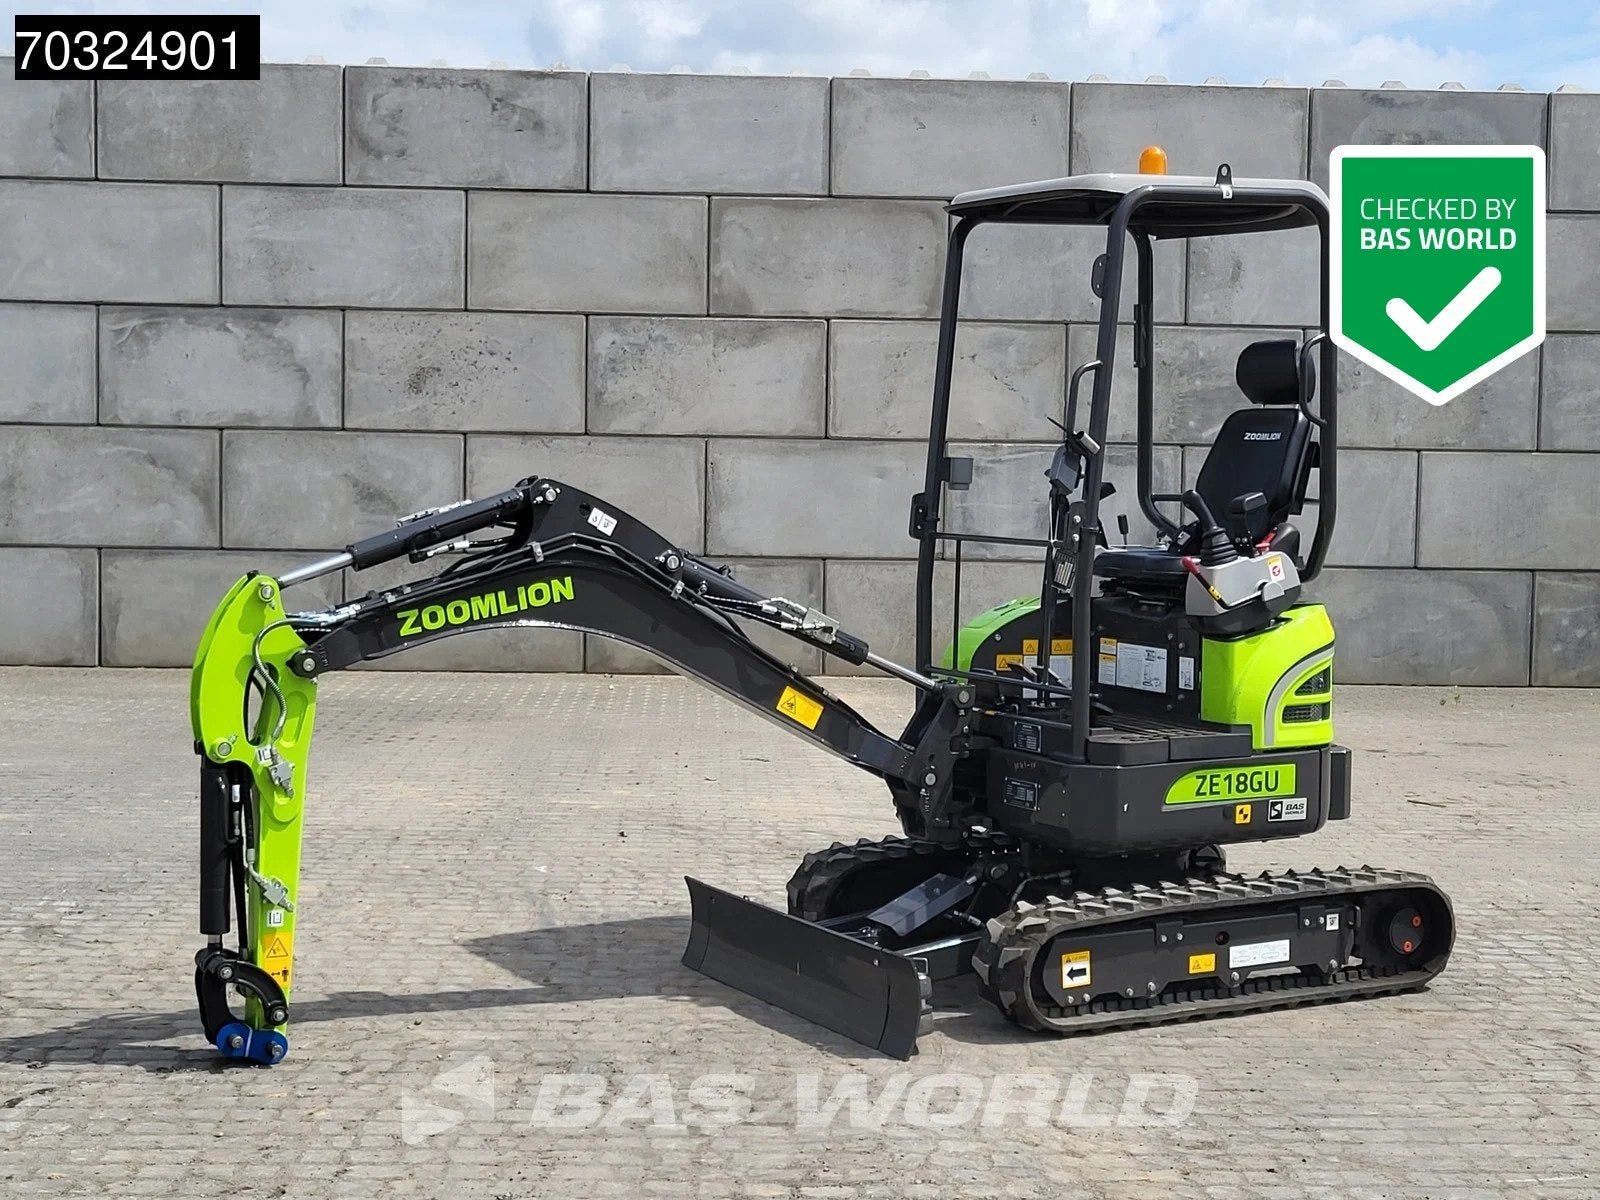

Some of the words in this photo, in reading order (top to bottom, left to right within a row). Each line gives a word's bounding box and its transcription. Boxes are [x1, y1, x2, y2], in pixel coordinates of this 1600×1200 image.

[1243, 432, 1282, 441] ZOOMLION
[396, 576, 575, 637] ZOOMLION
[1195, 771, 1279, 797] ZE18GU
[1286, 803, 1305, 811] BAS
